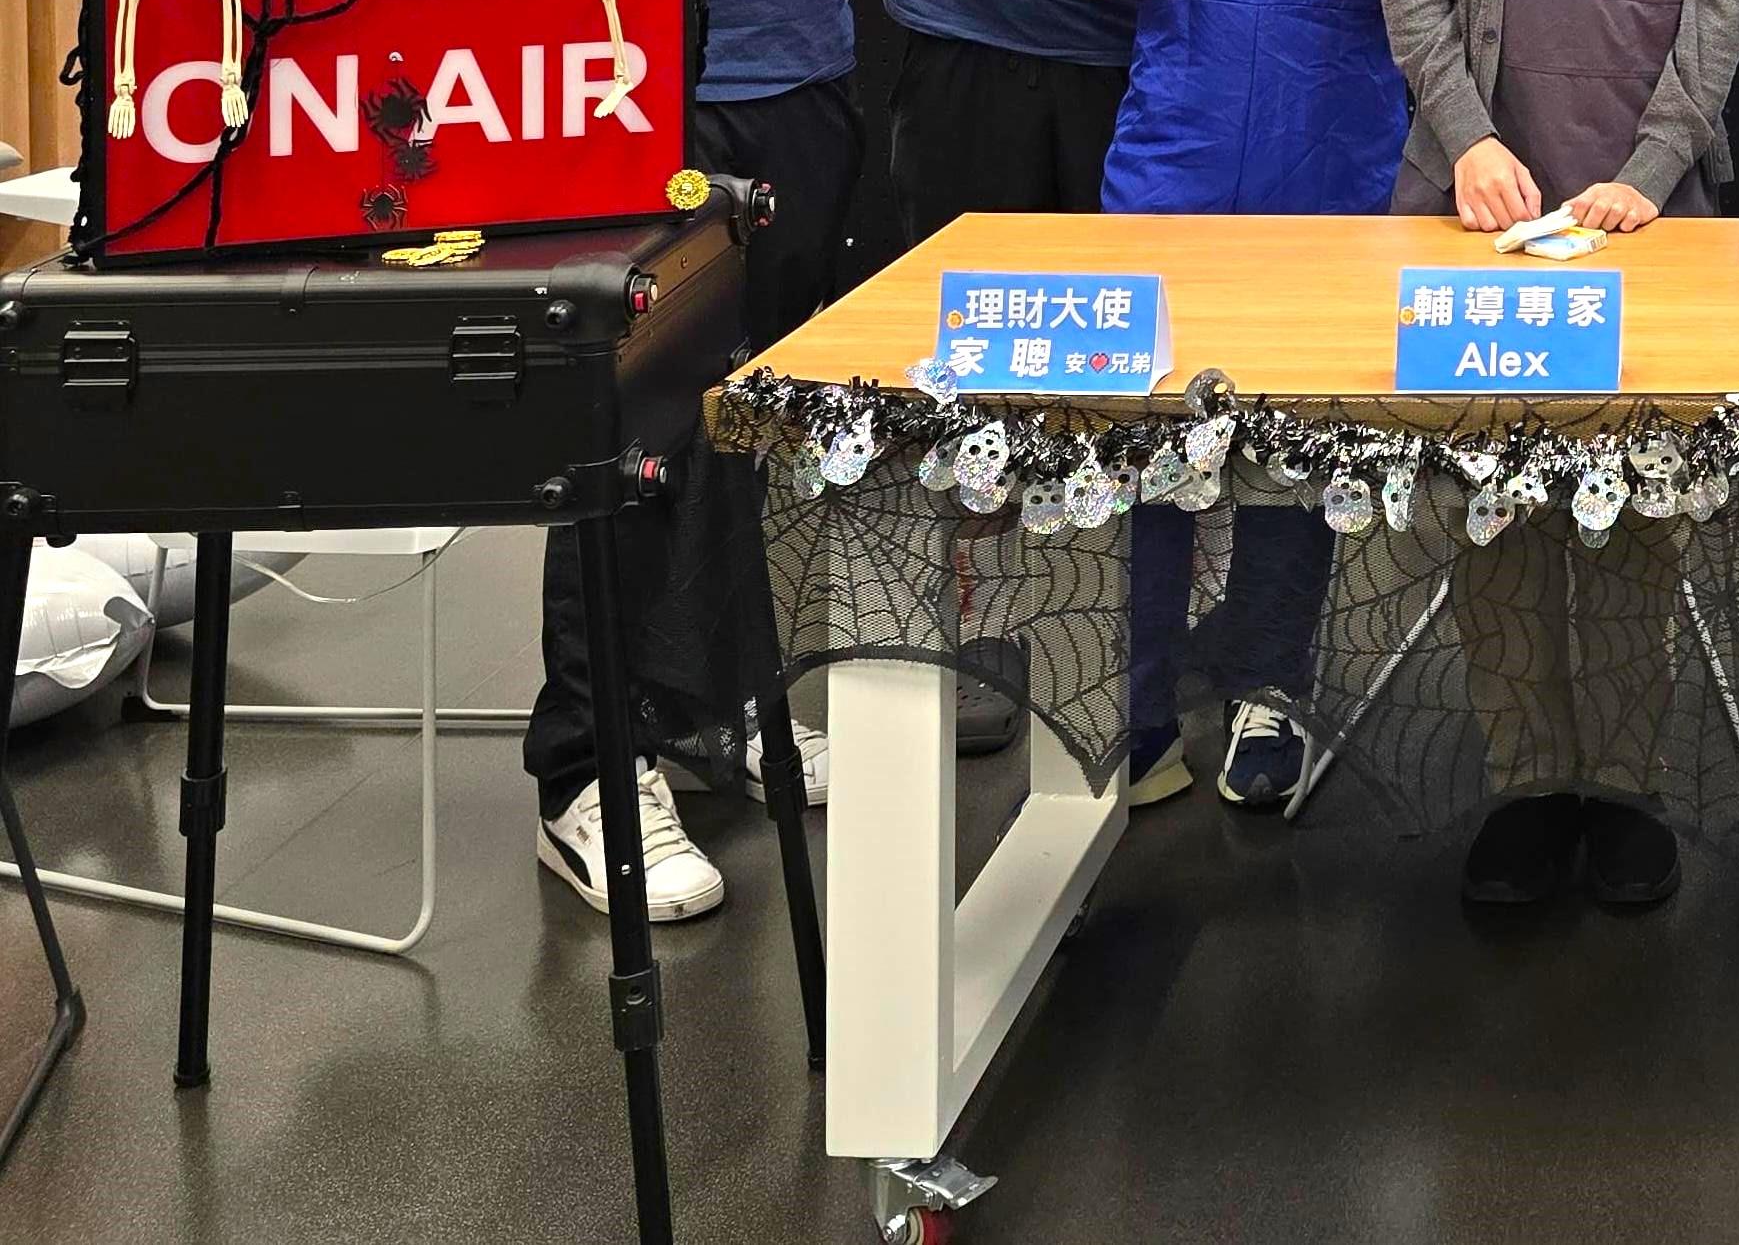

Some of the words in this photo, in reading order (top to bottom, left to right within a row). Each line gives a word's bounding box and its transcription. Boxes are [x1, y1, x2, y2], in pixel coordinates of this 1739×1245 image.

[141, 54, 359, 165] ON
[409, 41, 655, 147] AIR
[964, 287, 1132, 330] 理財大使
[1412, 285, 1607, 327] 輔導專家
[1454, 341, 1550, 378] Alex
